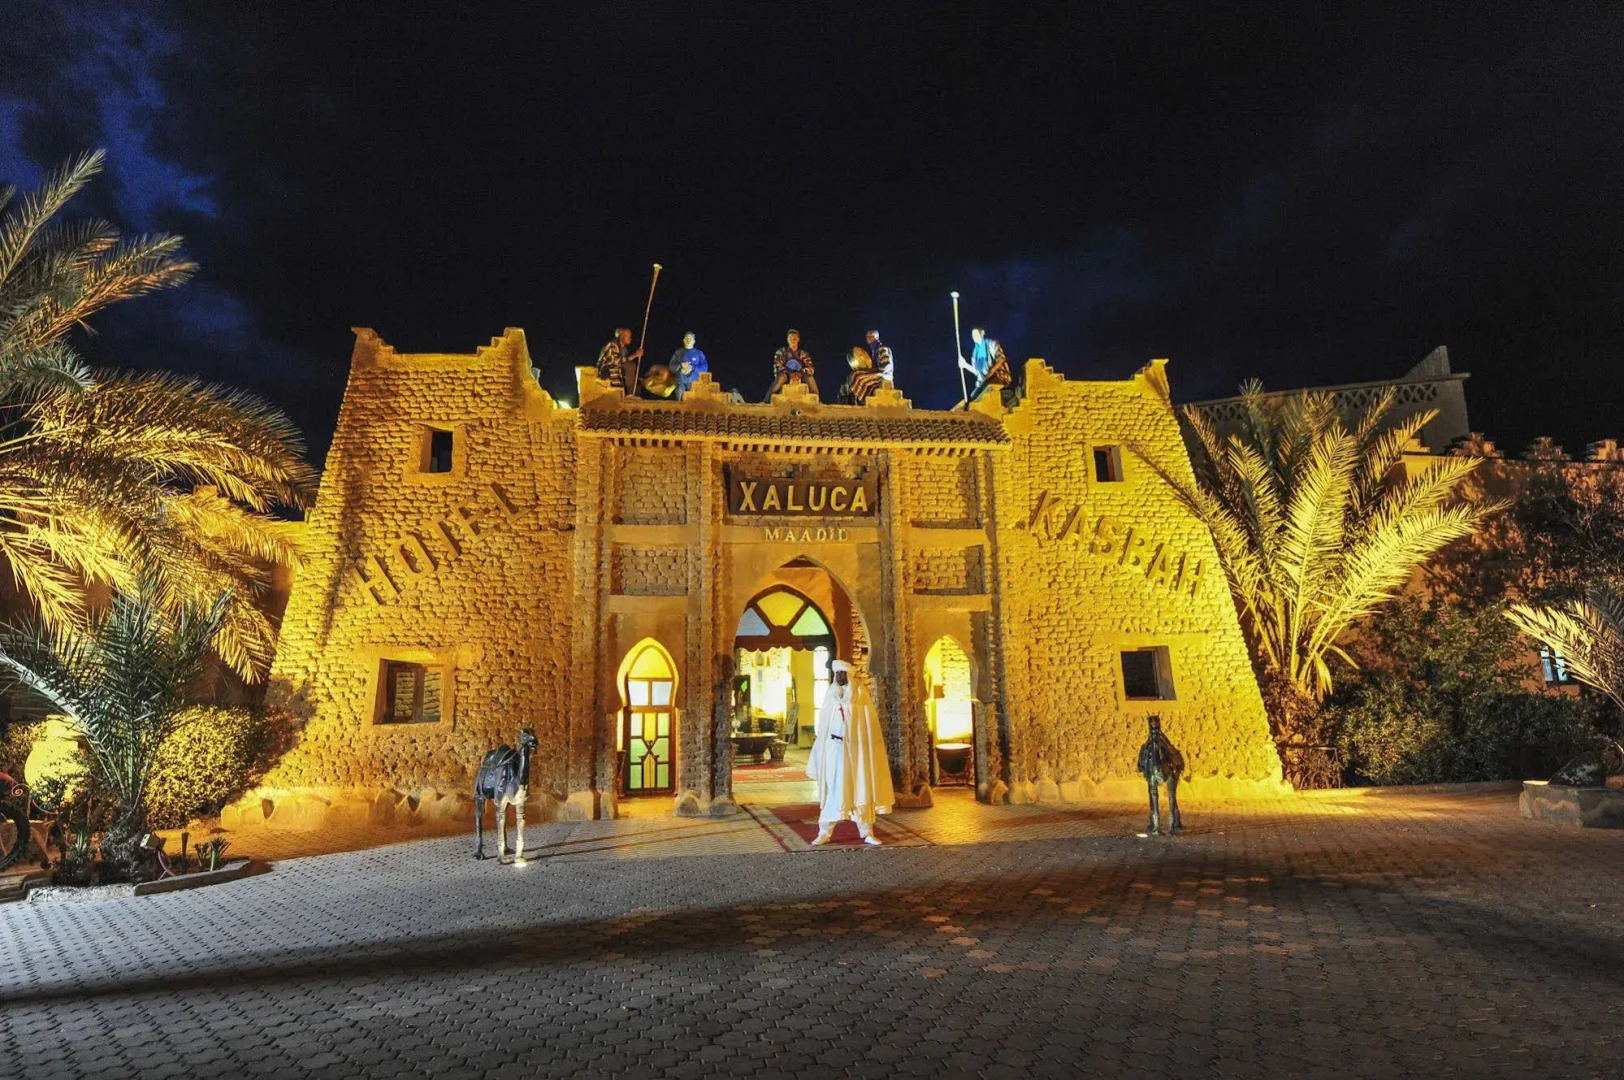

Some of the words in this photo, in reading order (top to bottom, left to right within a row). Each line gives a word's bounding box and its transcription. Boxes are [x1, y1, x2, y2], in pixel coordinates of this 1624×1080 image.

[352, 482, 533, 605] HOTEL
[739, 481, 868, 512] XALUCA
[1029, 490, 1206, 599] KASBAH
